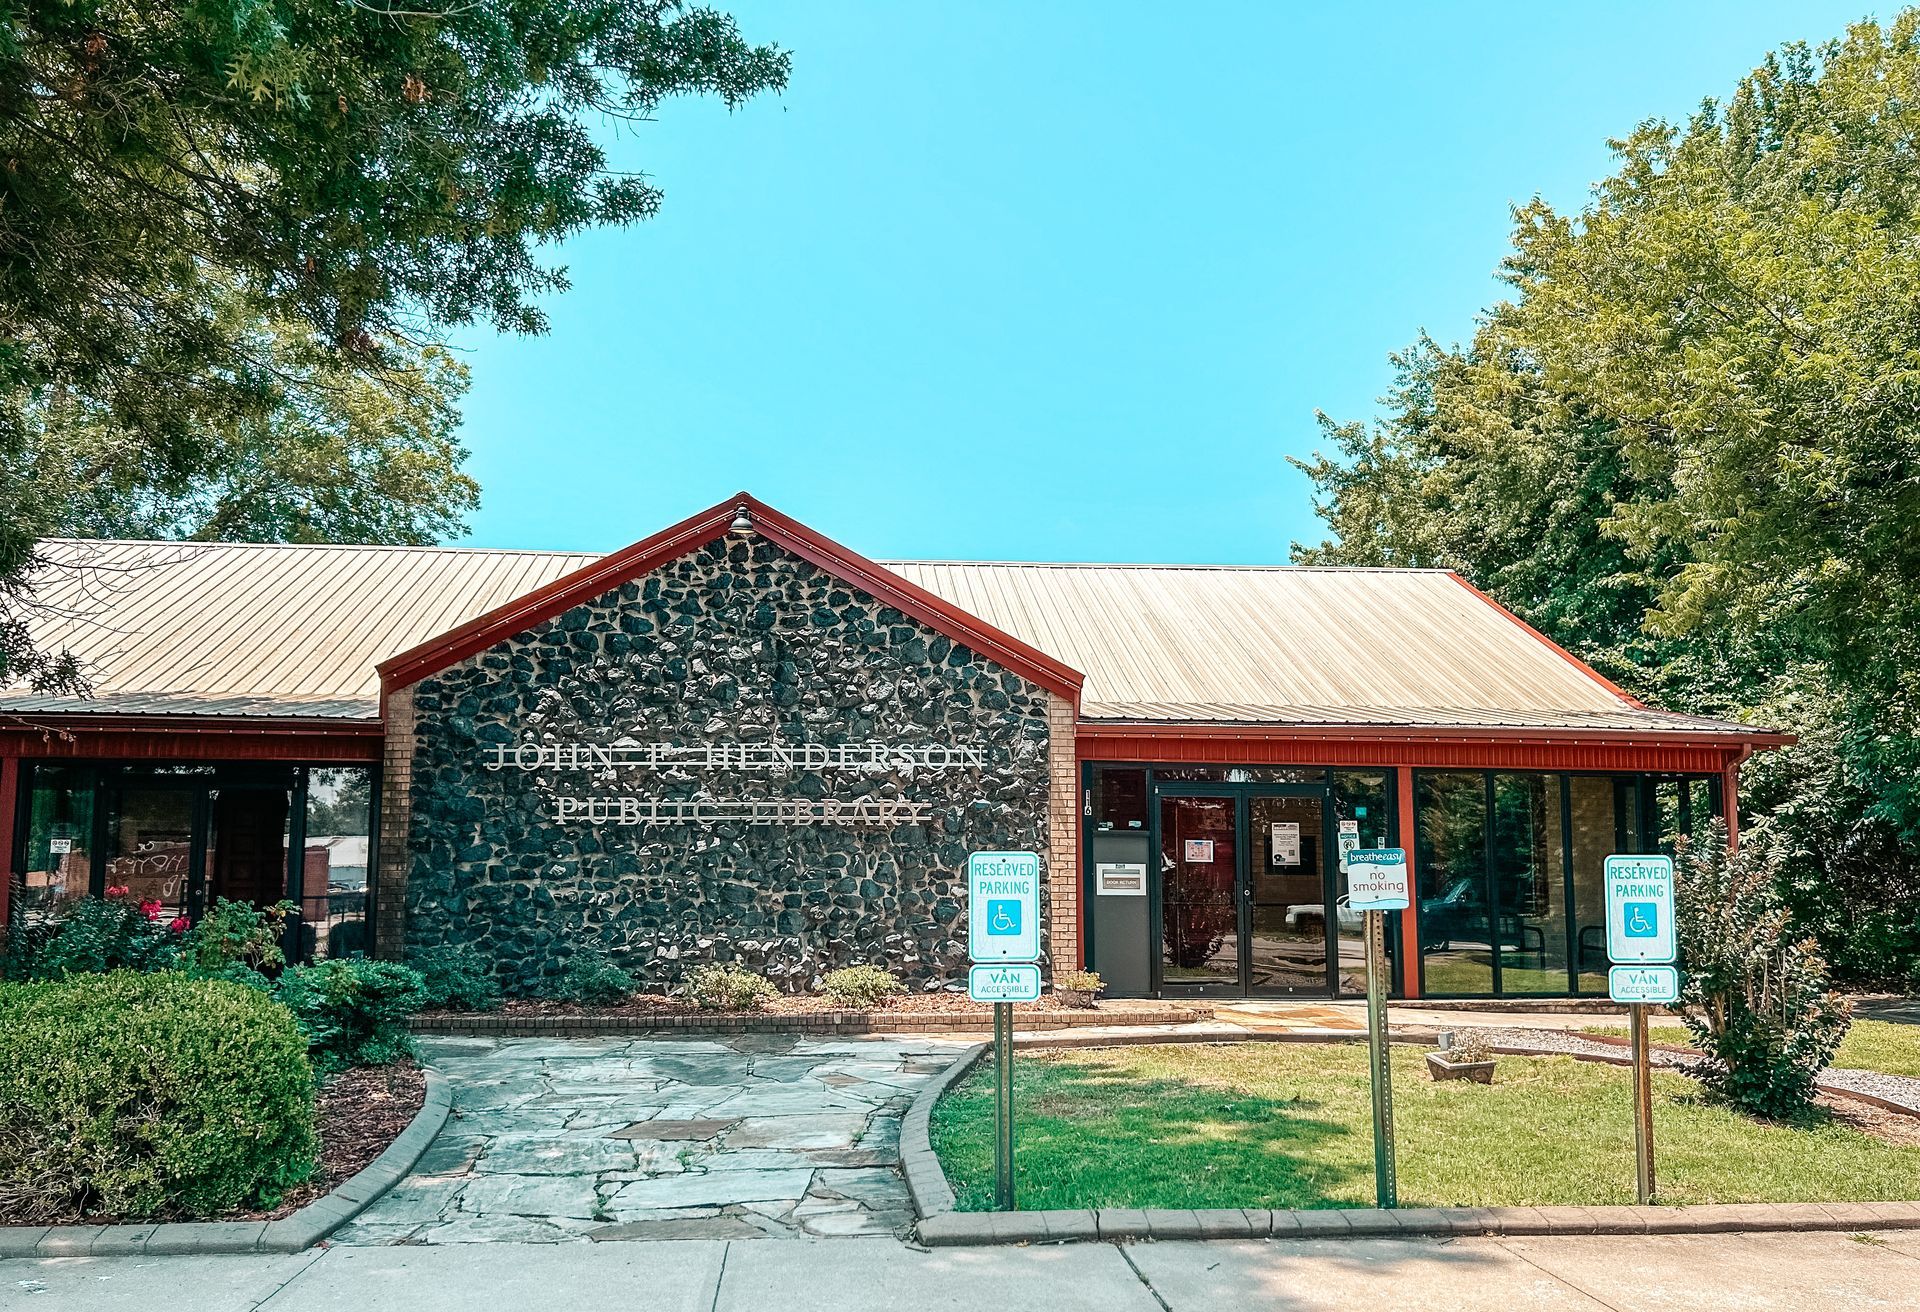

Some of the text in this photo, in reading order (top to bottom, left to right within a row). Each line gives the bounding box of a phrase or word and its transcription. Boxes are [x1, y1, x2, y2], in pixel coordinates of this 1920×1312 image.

[487, 743, 985, 772] JOHN F HENDERSON
[555, 797, 929, 827] PUBLIC LIBRARY
[1350, 852, 1403, 864] breatheeasy
[974, 863, 1034, 876] RESERVED
[1610, 866, 1668, 880] RESERVED
[1369, 872, 1385, 880] no
[979, 881, 1029, 894] PARKING
[1353, 881, 1404, 893] smoking
[1615, 884, 1664, 897] PARKING
[990, 973, 1020, 983] VAN
[1628, 974, 1658, 984] VAN
[980, 985, 1029, 993] ACCESSIBLE
[1620, 986, 1667, 994] ACCESSIBLE
